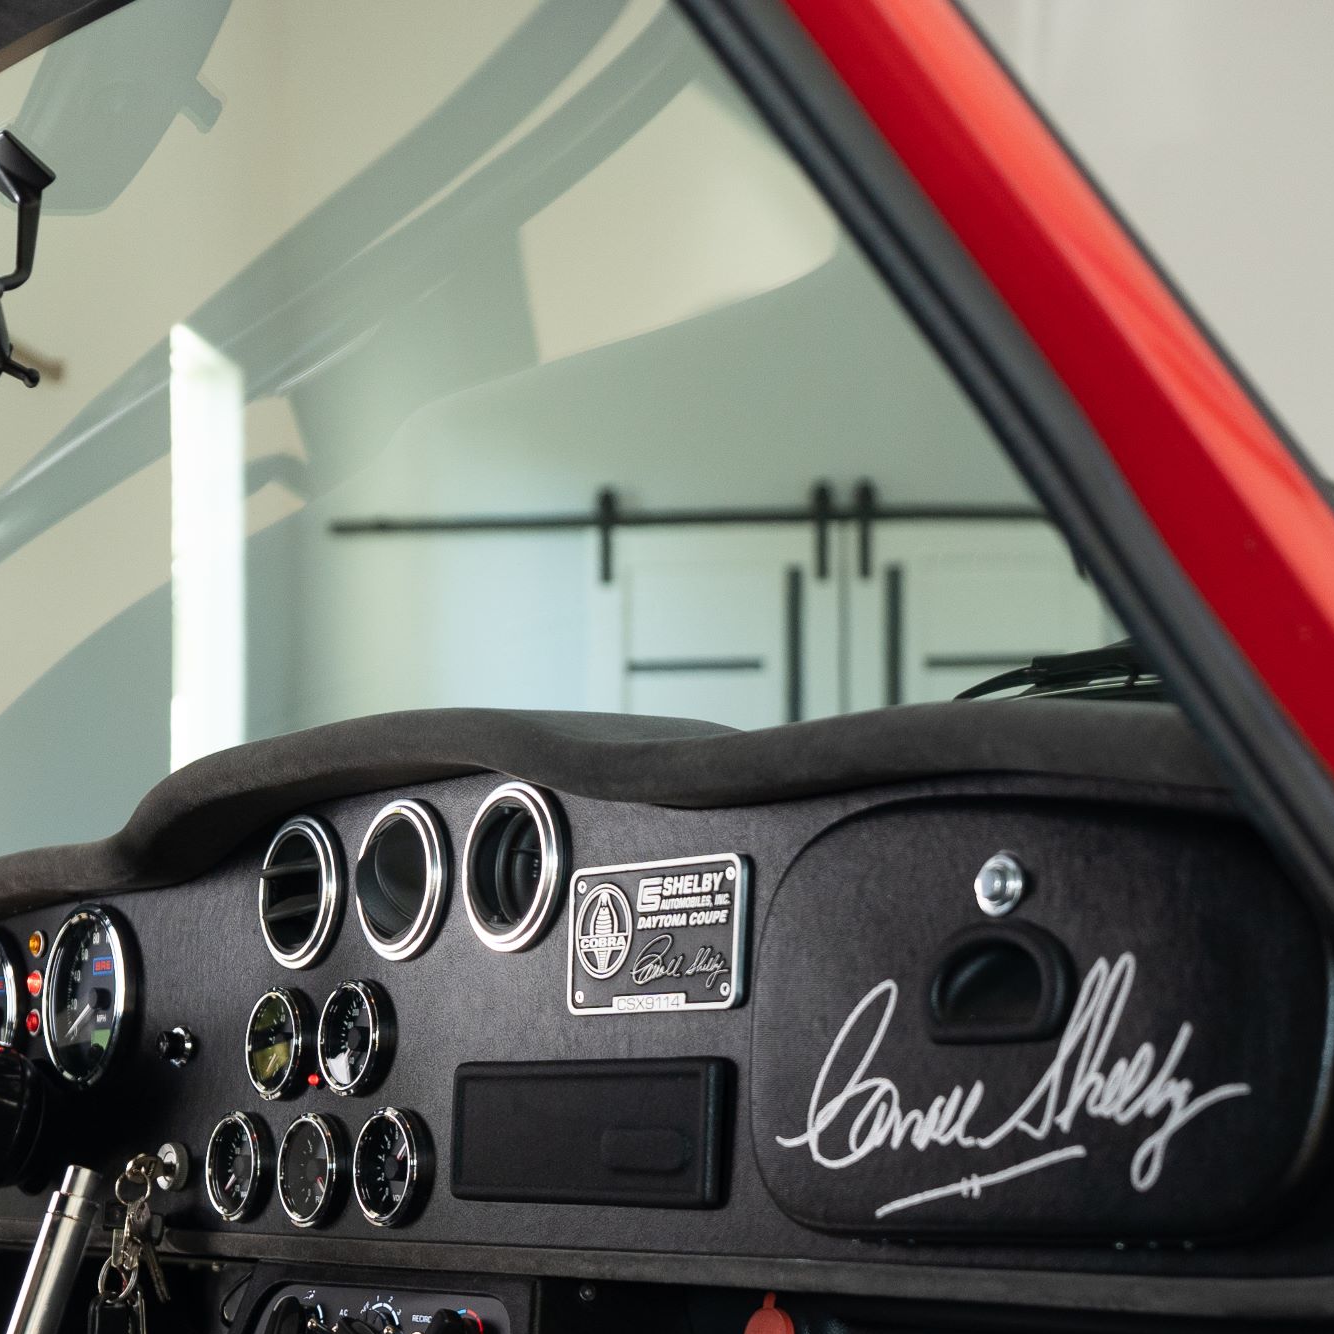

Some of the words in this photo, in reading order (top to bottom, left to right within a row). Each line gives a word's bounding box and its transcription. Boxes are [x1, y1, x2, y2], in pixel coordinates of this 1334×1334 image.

[662, 871, 724, 896] SHELBY
[660, 896, 714, 911] AUTOMOBILES,
[715, 893, 732, 906] INC.
[637, 914, 687, 930] DAYTONA
[689, 910, 729, 926] COUPE
[580, 936, 627, 949] COBRA
[617, 995, 681, 1011] CSX9114
[338, 1308, 348, 1317] AC
